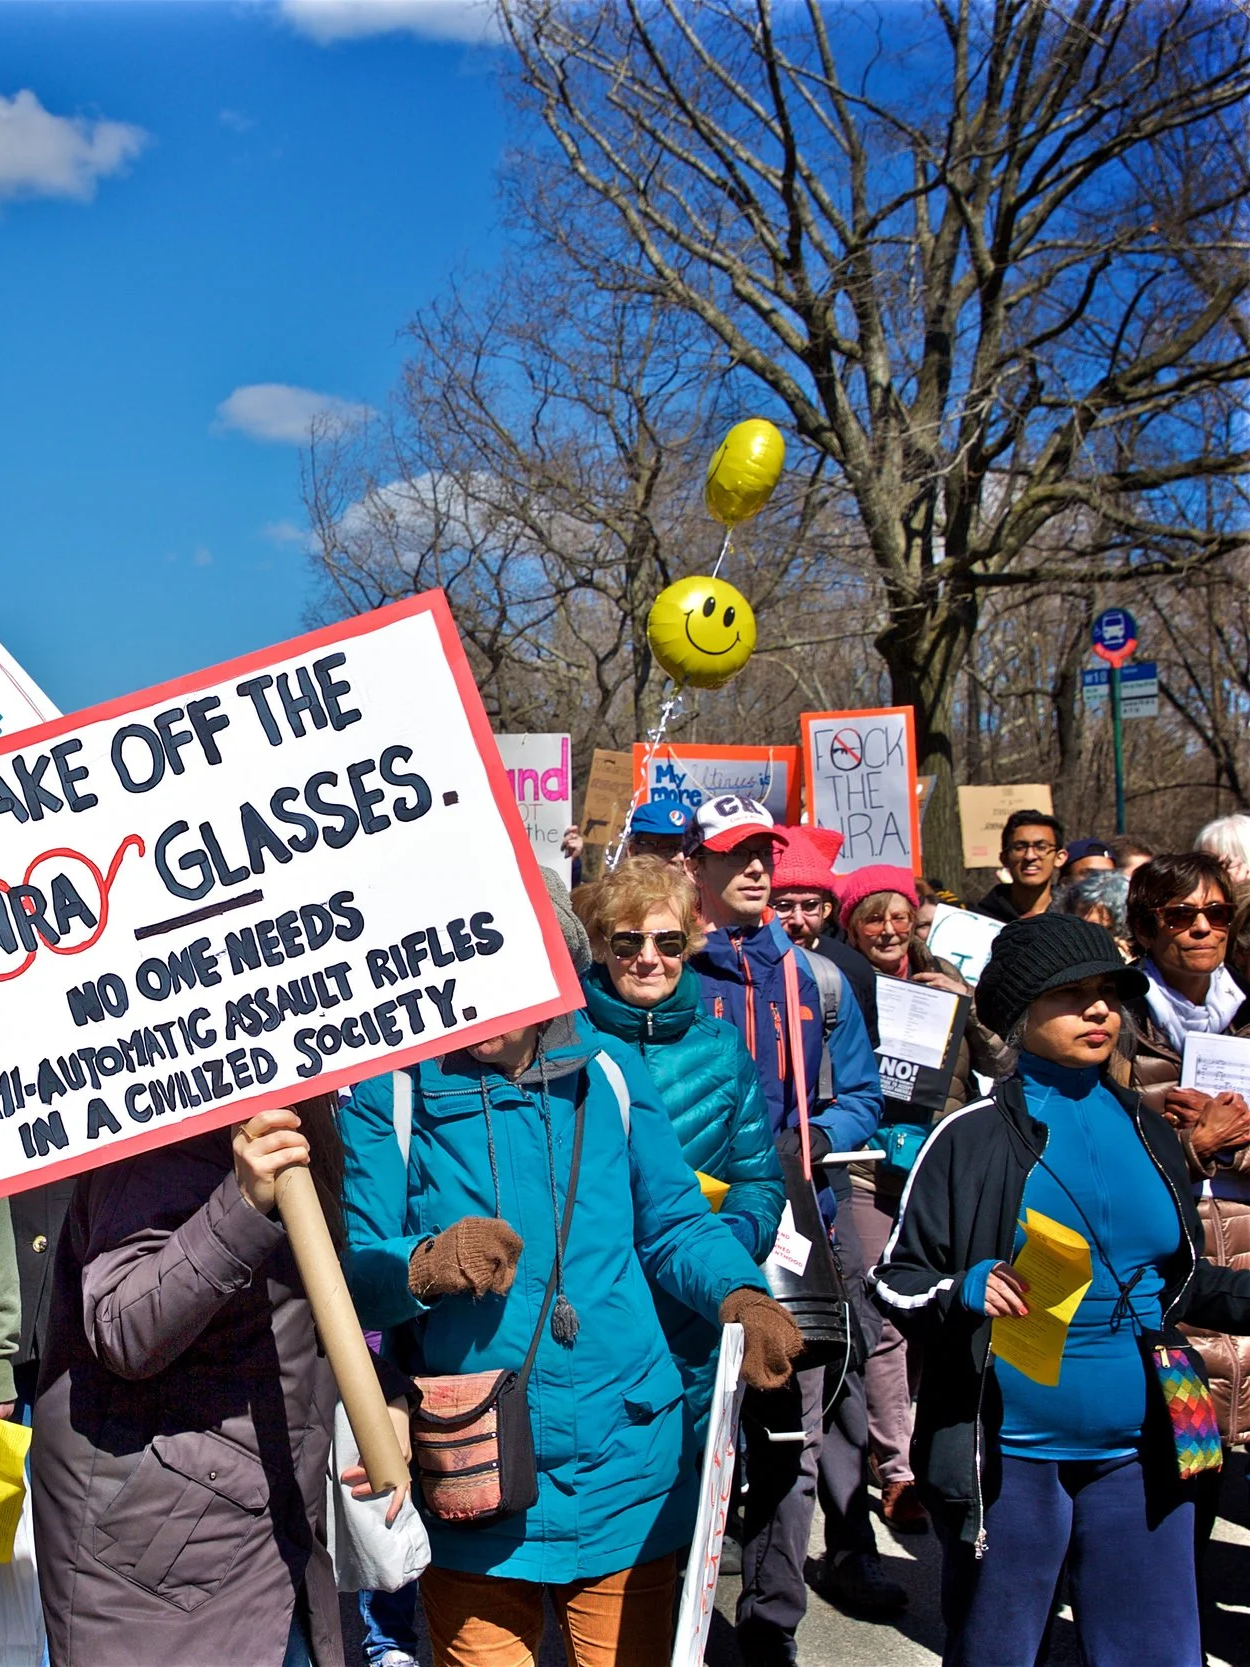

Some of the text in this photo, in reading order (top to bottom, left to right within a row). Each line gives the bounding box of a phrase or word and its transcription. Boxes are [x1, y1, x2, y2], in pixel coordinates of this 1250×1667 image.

[111, 696, 230, 794] OFF
[236, 652, 362, 747] THE
[655, 763, 686, 788] My
[758, 772, 772, 786] is
[154, 745, 459, 901] GLASSES.
[650, 786, 702, 807] more
[824, 771, 884, 811] THE
[66, 890, 365, 1026] NO ONE NEEDS
[225, 961, 353, 1041] ASSAULT
[366, 911, 504, 989] RIFLES
[18, 978, 478, 1158] IN A CIVILIZED SOCIETY.
[879, 1056, 919, 1082] NO!
